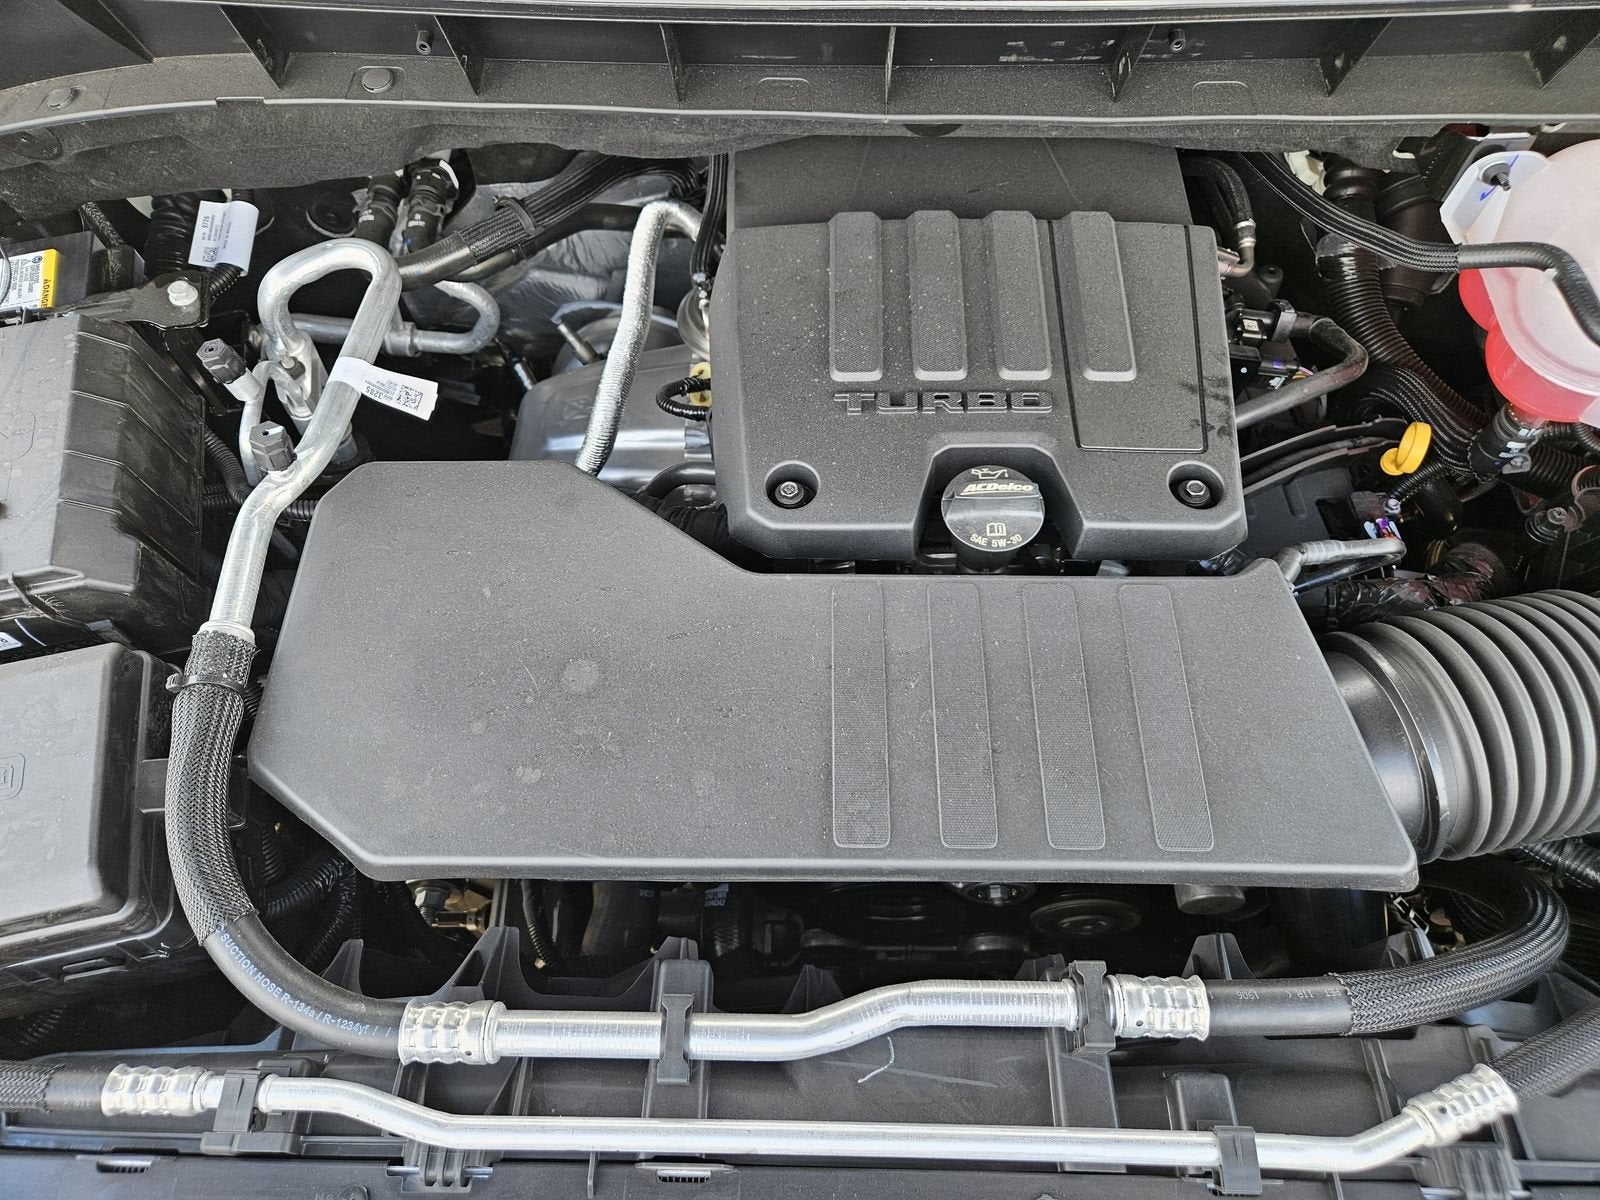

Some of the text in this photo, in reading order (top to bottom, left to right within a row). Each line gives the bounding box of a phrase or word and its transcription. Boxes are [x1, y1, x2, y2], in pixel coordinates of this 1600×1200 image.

[366, 385, 383, 400] 3285
[834, 391, 1053, 415] TURBO
[961, 482, 1034, 495] ACDelco
[969, 533, 1023, 549] SAE 5W-30
[220, 933, 257, 976] SUCTION
[254, 971, 282, 998] HOSE
